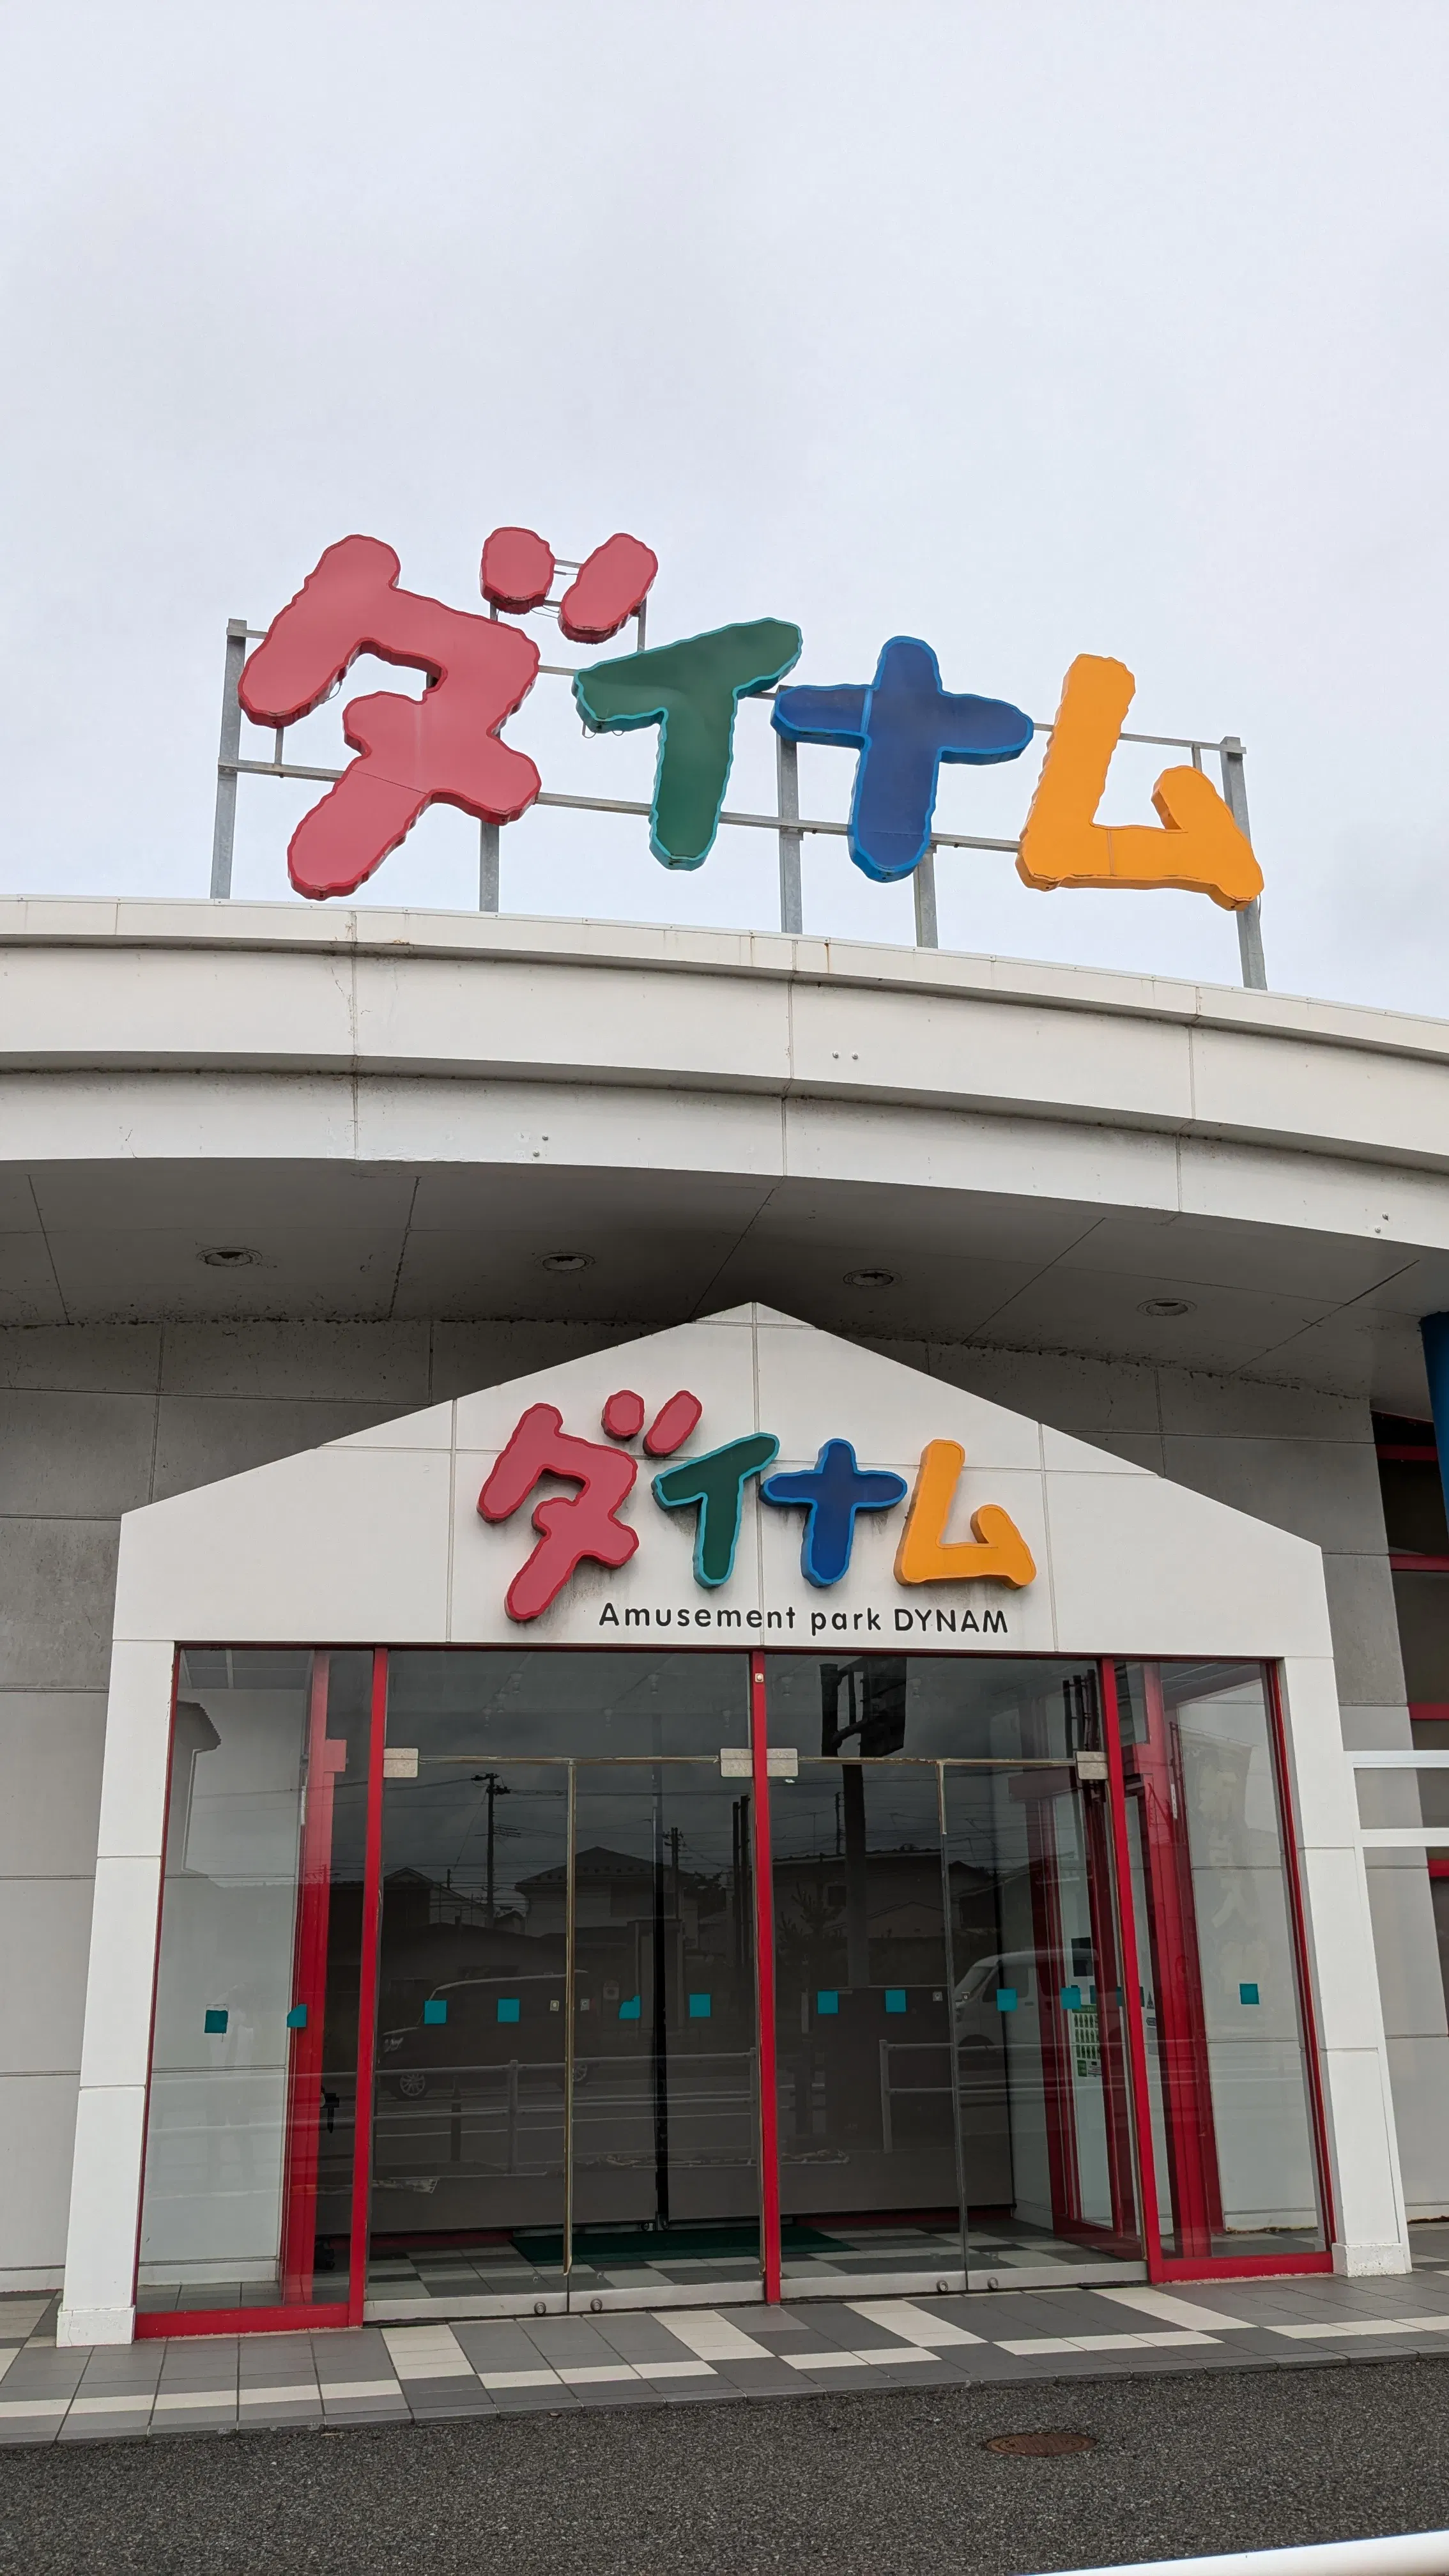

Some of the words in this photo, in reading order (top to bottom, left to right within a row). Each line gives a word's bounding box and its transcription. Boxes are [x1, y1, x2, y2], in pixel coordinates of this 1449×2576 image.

[238, 526, 1265, 912] ダイナム
[477, 1390, 1036, 1623] ダイナム
[598, 1602, 796, 1629] Amusement
[810, 1607, 882, 1636] park
[894, 1608, 1009, 1634] DYNAM
